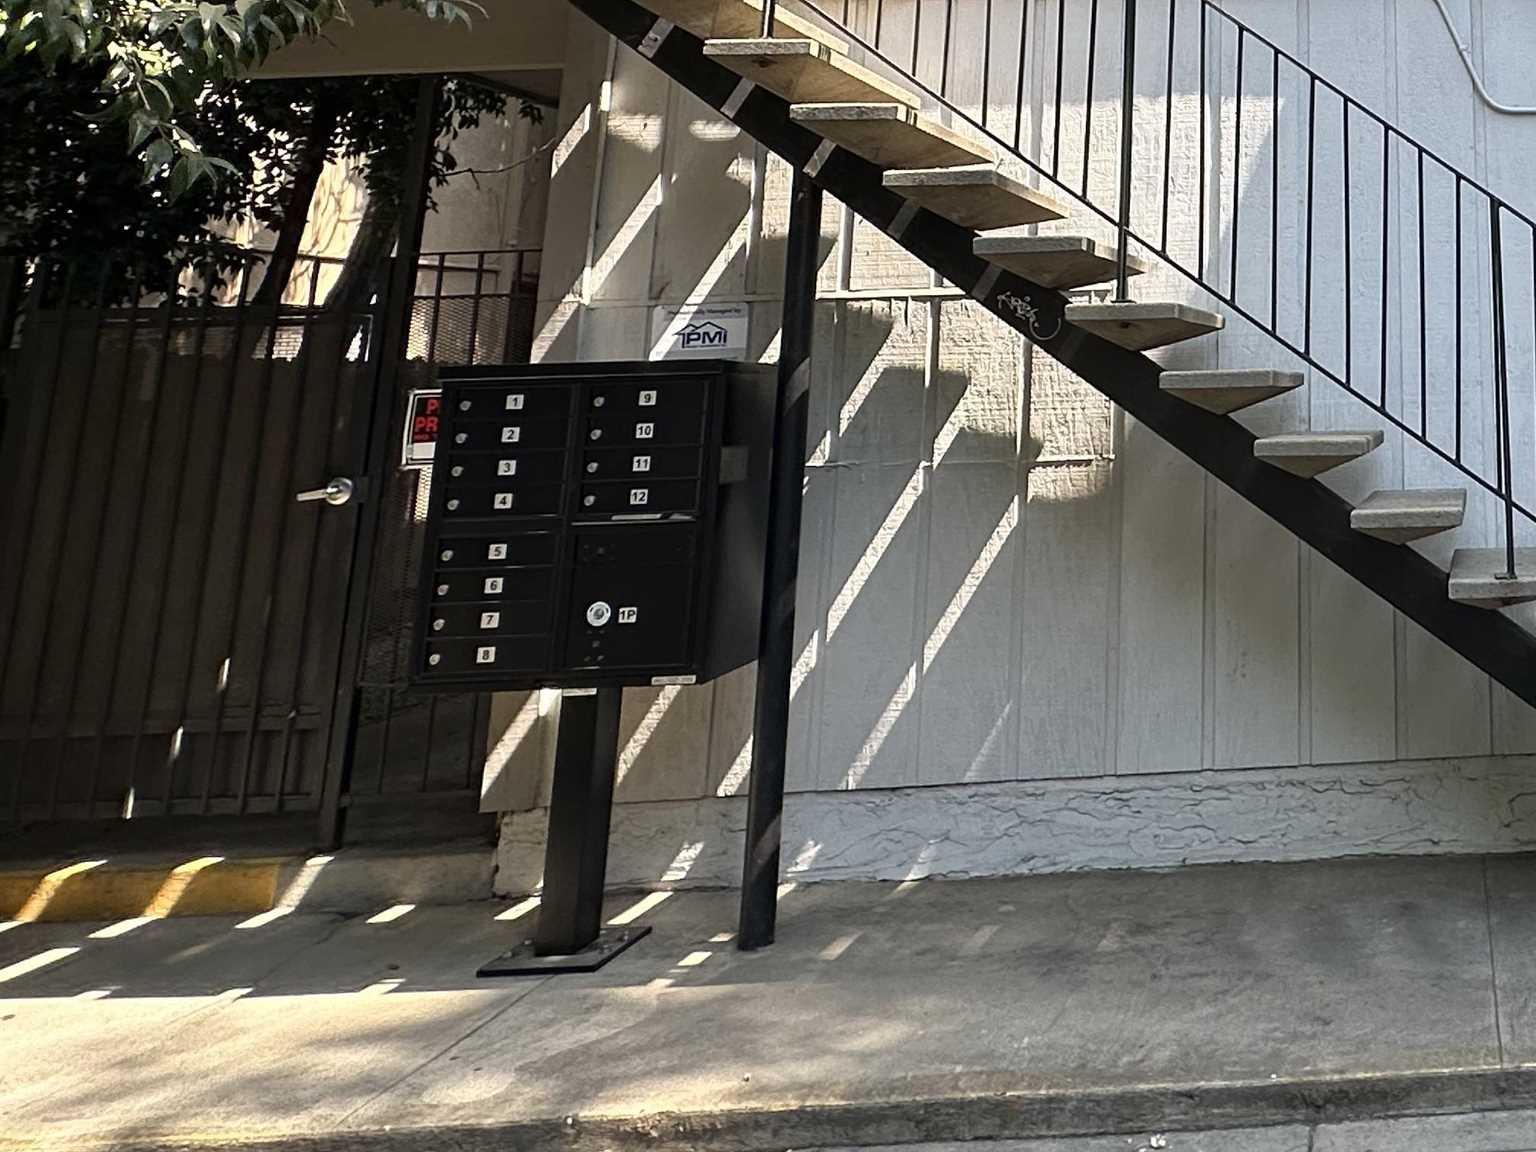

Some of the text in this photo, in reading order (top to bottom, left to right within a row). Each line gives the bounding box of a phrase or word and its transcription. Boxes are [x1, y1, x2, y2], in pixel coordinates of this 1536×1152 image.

[512, 397, 518, 407] 1
[644, 393, 652, 403] 9
[507, 429, 515, 440] 2
[638, 425, 652, 436] 10
[503, 462, 511, 473] 3
[635, 458, 649, 469] 11
[499, 495, 508, 506] 4
[632, 491, 646, 502] 12
[494, 546, 502, 557] 5
[490, 580, 498, 591] 6
[486, 615, 494, 625] 7
[620, 609, 636, 620] 1P
[482, 649, 490, 660] 8
